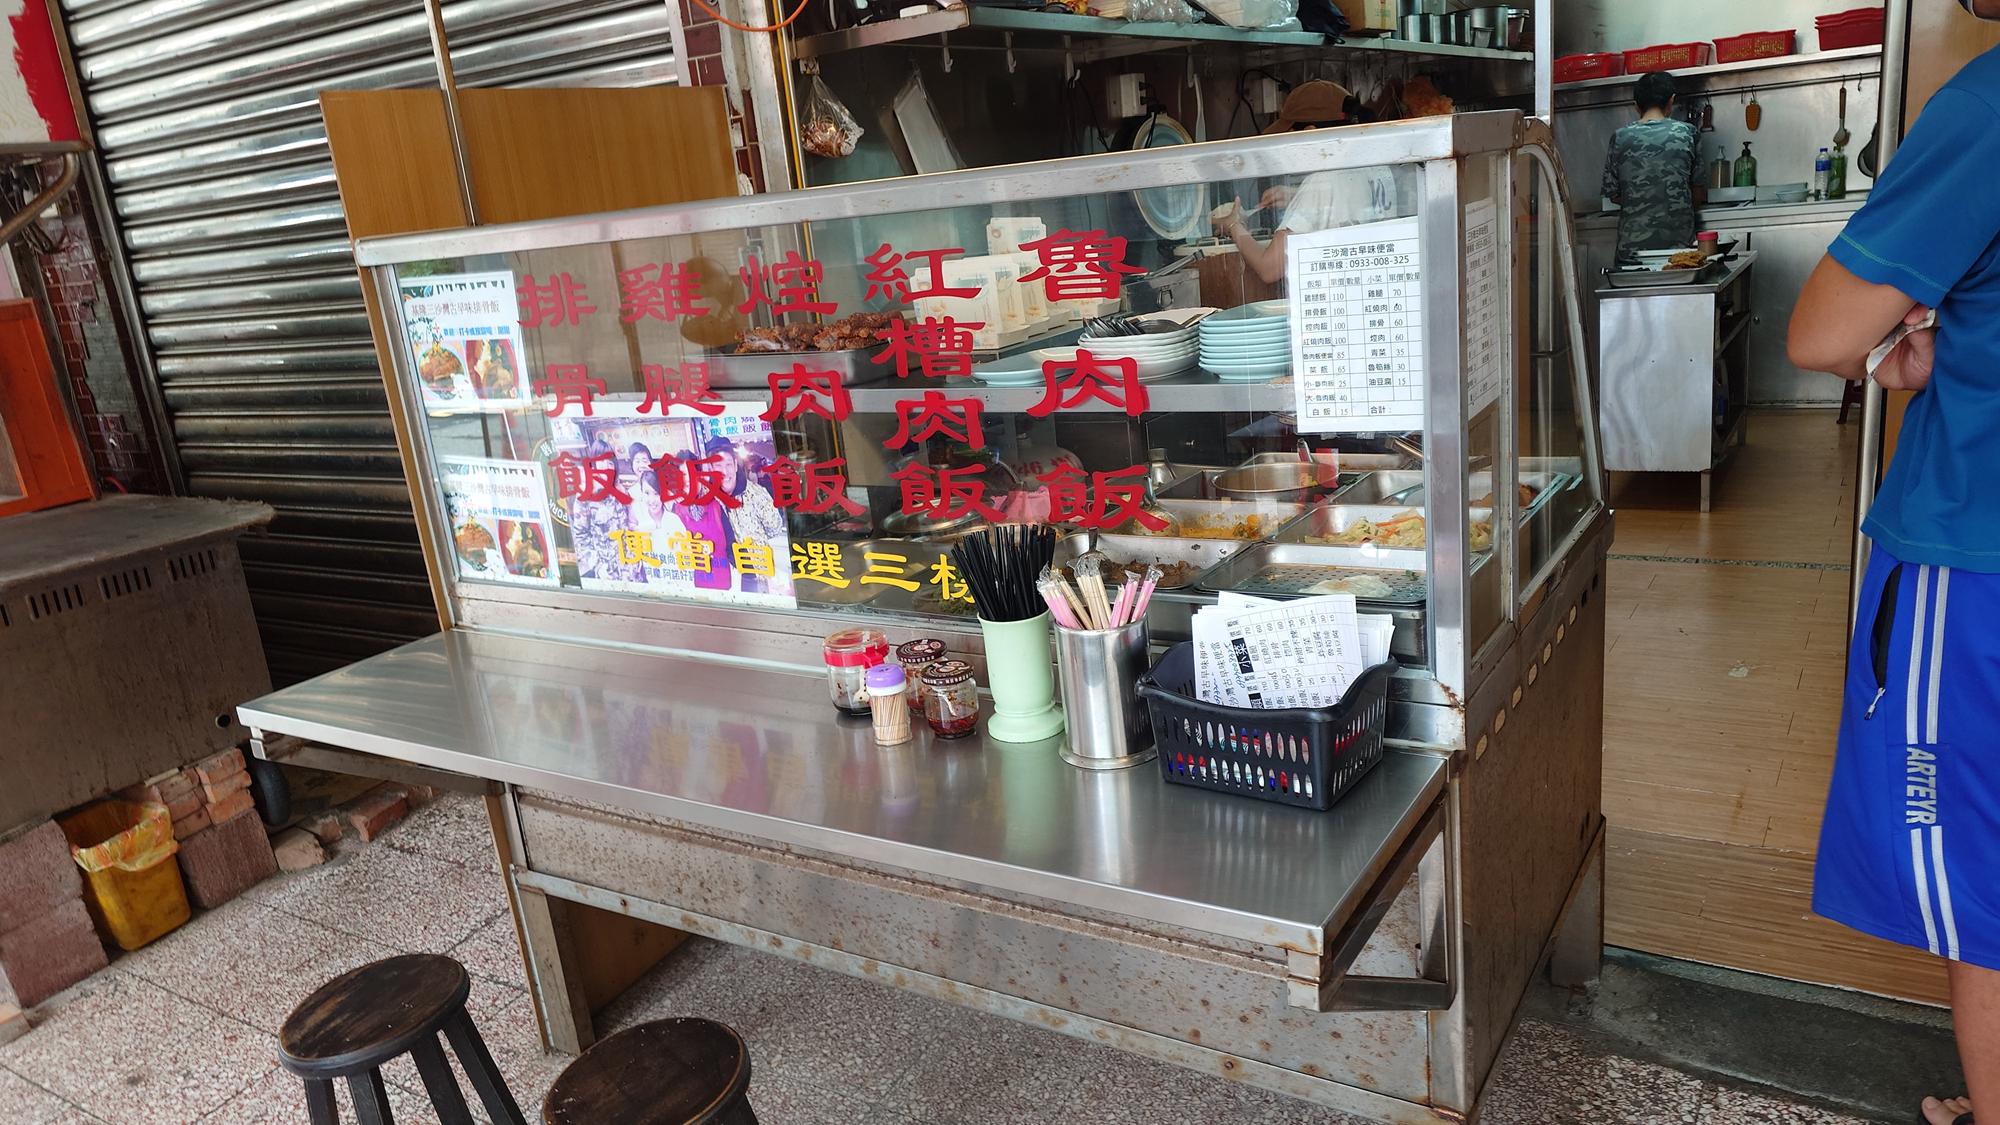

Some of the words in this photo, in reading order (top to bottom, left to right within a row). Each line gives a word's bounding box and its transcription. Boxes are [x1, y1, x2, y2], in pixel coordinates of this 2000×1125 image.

[1322, 243, 1395, 259] 三沙灣古早味便當
[1332, 293, 1344, 301] 110
[1393, 288, 1402, 297] 70
[1305, 308, 1327, 317] 排骨飯
[1333, 307, 1345, 316] 100
[1365, 304, 1388, 313] 紅燒肉
[1393, 303, 1403, 311] 60
[1334, 322, 1346, 330] 100
[1369, 319, 1385, 327] 排骨
[1335, 337, 1347, 345] 100
[1395, 333, 1404, 341] 60
[1371, 348, 1386, 357] 青菜
[1396, 348, 1405, 356] 35
[1397, 363, 1406, 371] 30
[619, 261, 743, 509] 雞腿飯
[1016, 228, 1170, 532] 魯肉飯
[1338, 380, 1346, 388] 25
[517, 273, 634, 505] 排骨飯
[1905, 746, 1937, 825] ARTEYR
